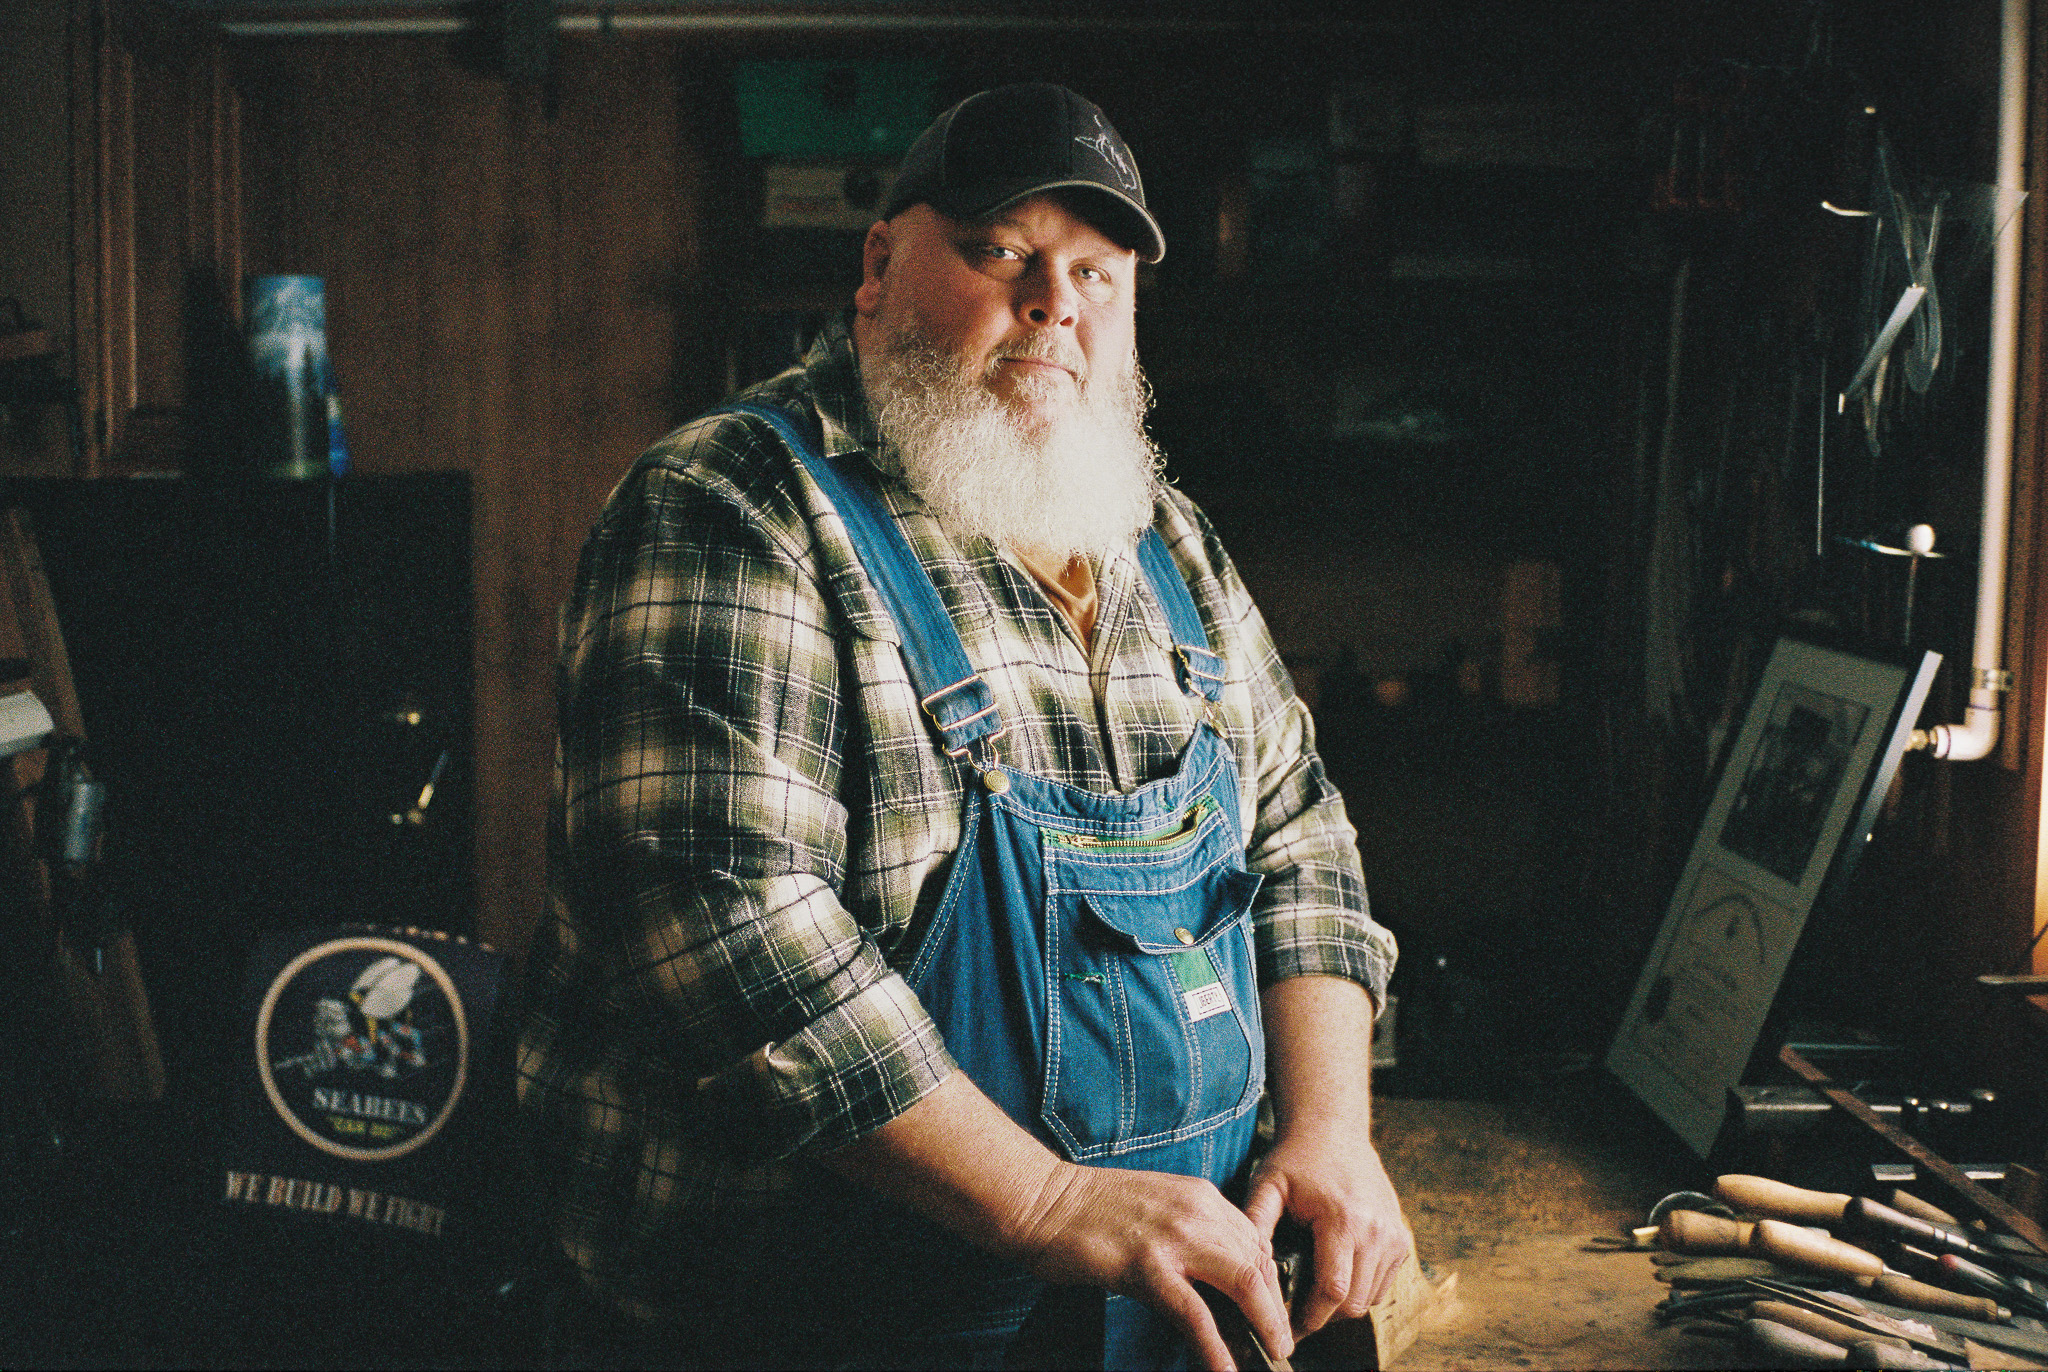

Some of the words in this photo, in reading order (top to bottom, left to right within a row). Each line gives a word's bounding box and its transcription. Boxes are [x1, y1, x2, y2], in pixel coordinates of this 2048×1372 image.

[312, 1087, 427, 1124] SEABEES
[226, 1170, 263, 1203] WE
[267, 1175, 343, 1214] BUILD
[347, 1187, 380, 1222] WE
